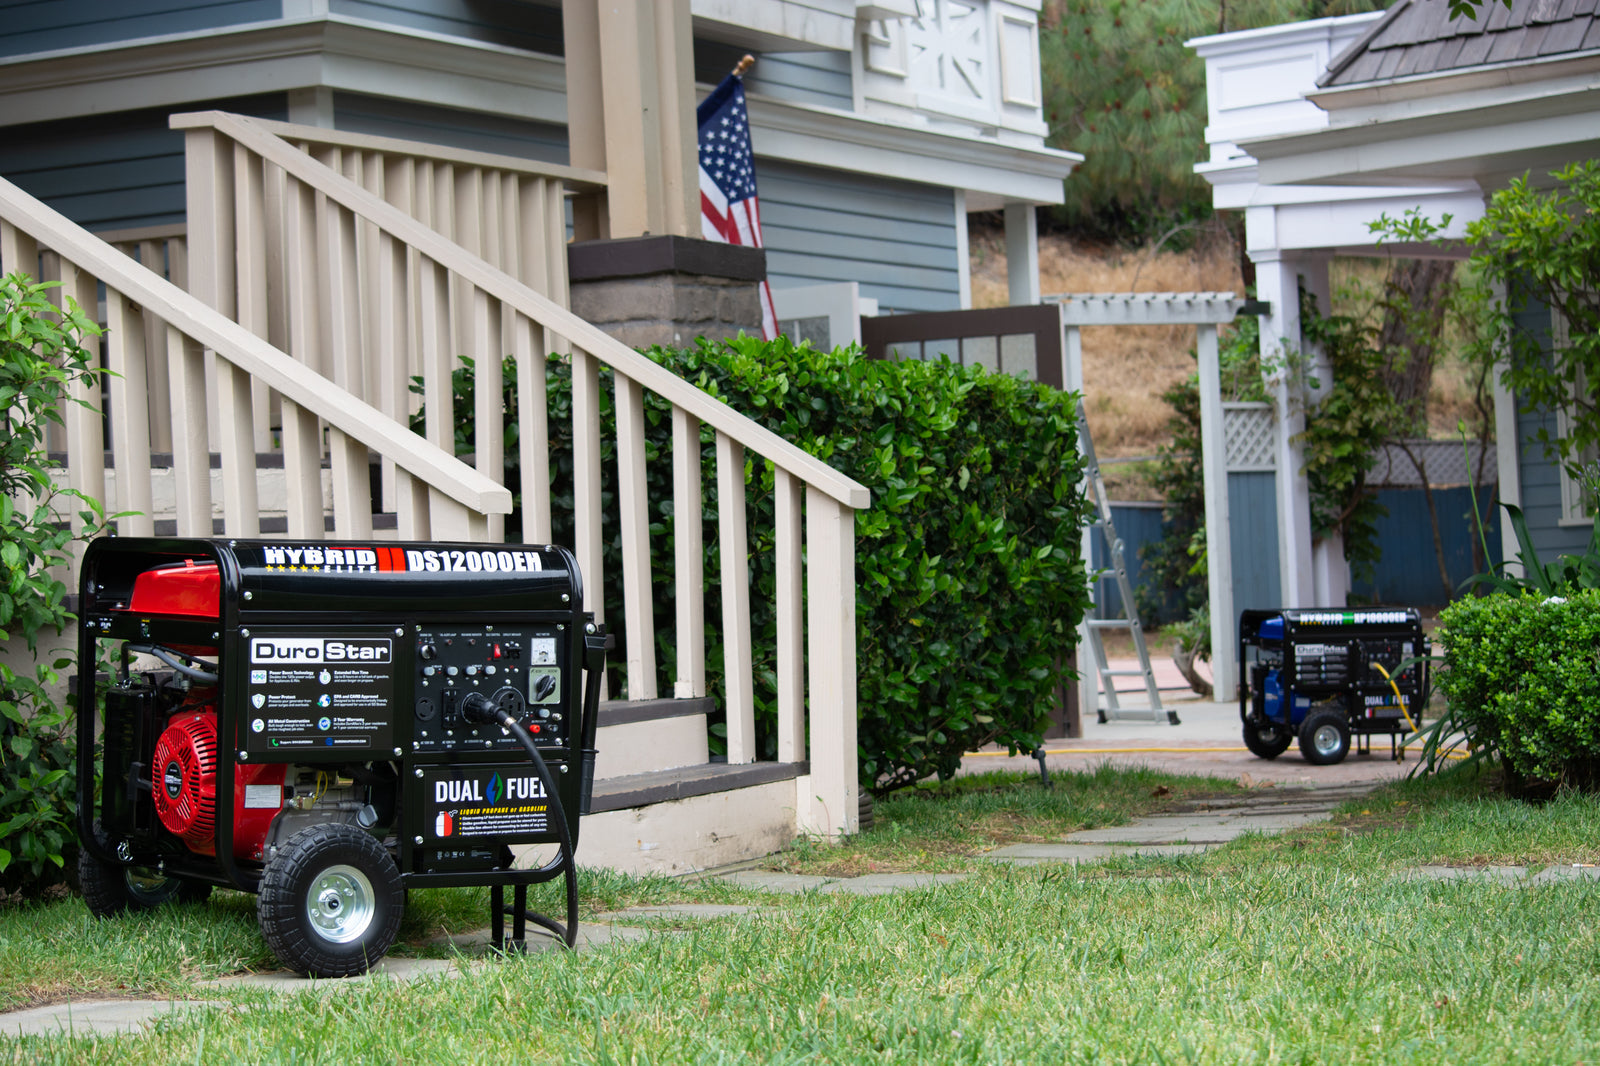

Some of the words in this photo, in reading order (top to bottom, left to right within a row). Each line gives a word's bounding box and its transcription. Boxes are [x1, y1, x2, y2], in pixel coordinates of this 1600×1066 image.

[263, 547, 376, 565] HYBRID
[406, 550, 543, 572] DS12000EH
[324, 565, 376, 573] ELITE
[435, 780, 483, 802] DUAL
[507, 777, 548, 800] FUEL
